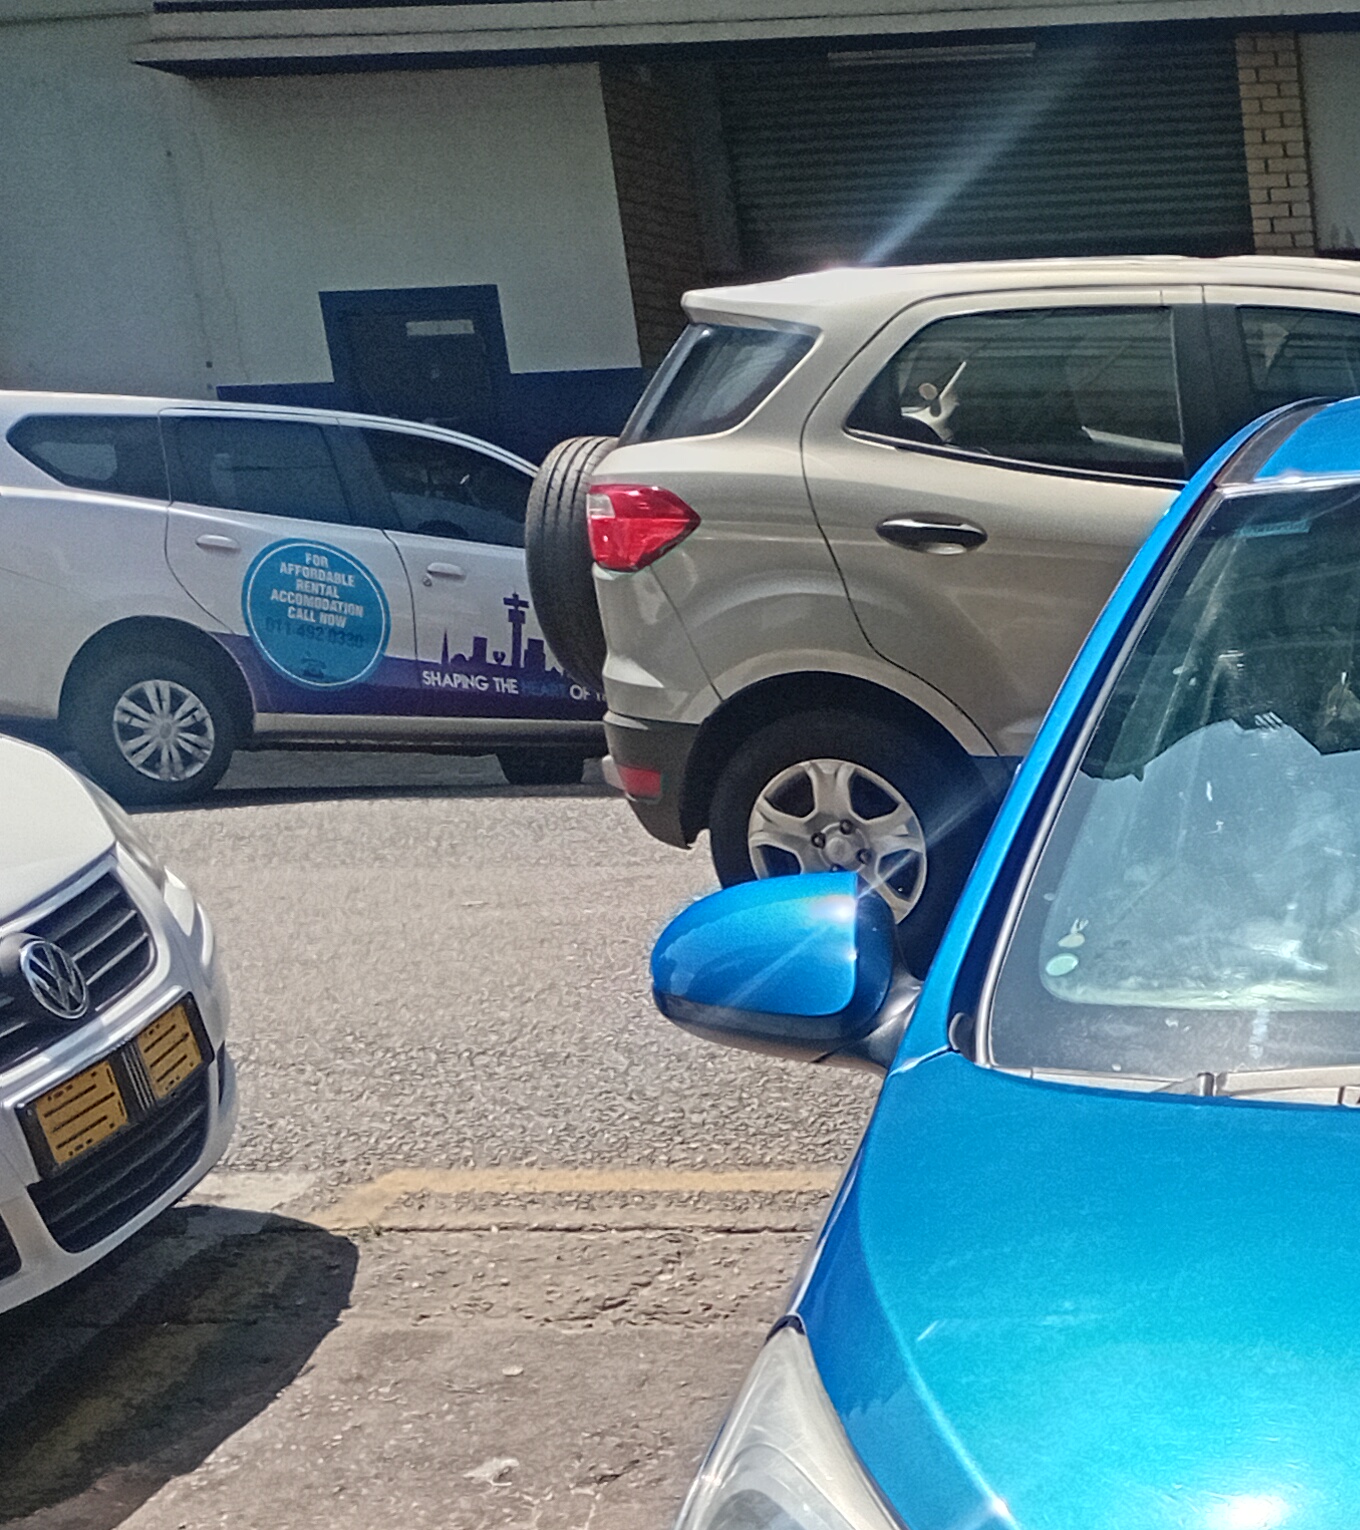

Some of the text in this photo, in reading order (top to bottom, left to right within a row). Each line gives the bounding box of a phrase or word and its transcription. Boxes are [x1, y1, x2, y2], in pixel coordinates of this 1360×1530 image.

[305, 552, 329, 567] FOR
[279, 562, 355, 586] AFFORDABLE
[295, 579, 340, 599] RENTAL
[270, 588, 364, 618] ACCOMODATION
[287, 606, 348, 628] CALL NOW
[422, 670, 490, 691] SHAPING
[492, 677, 519, 695] THE
